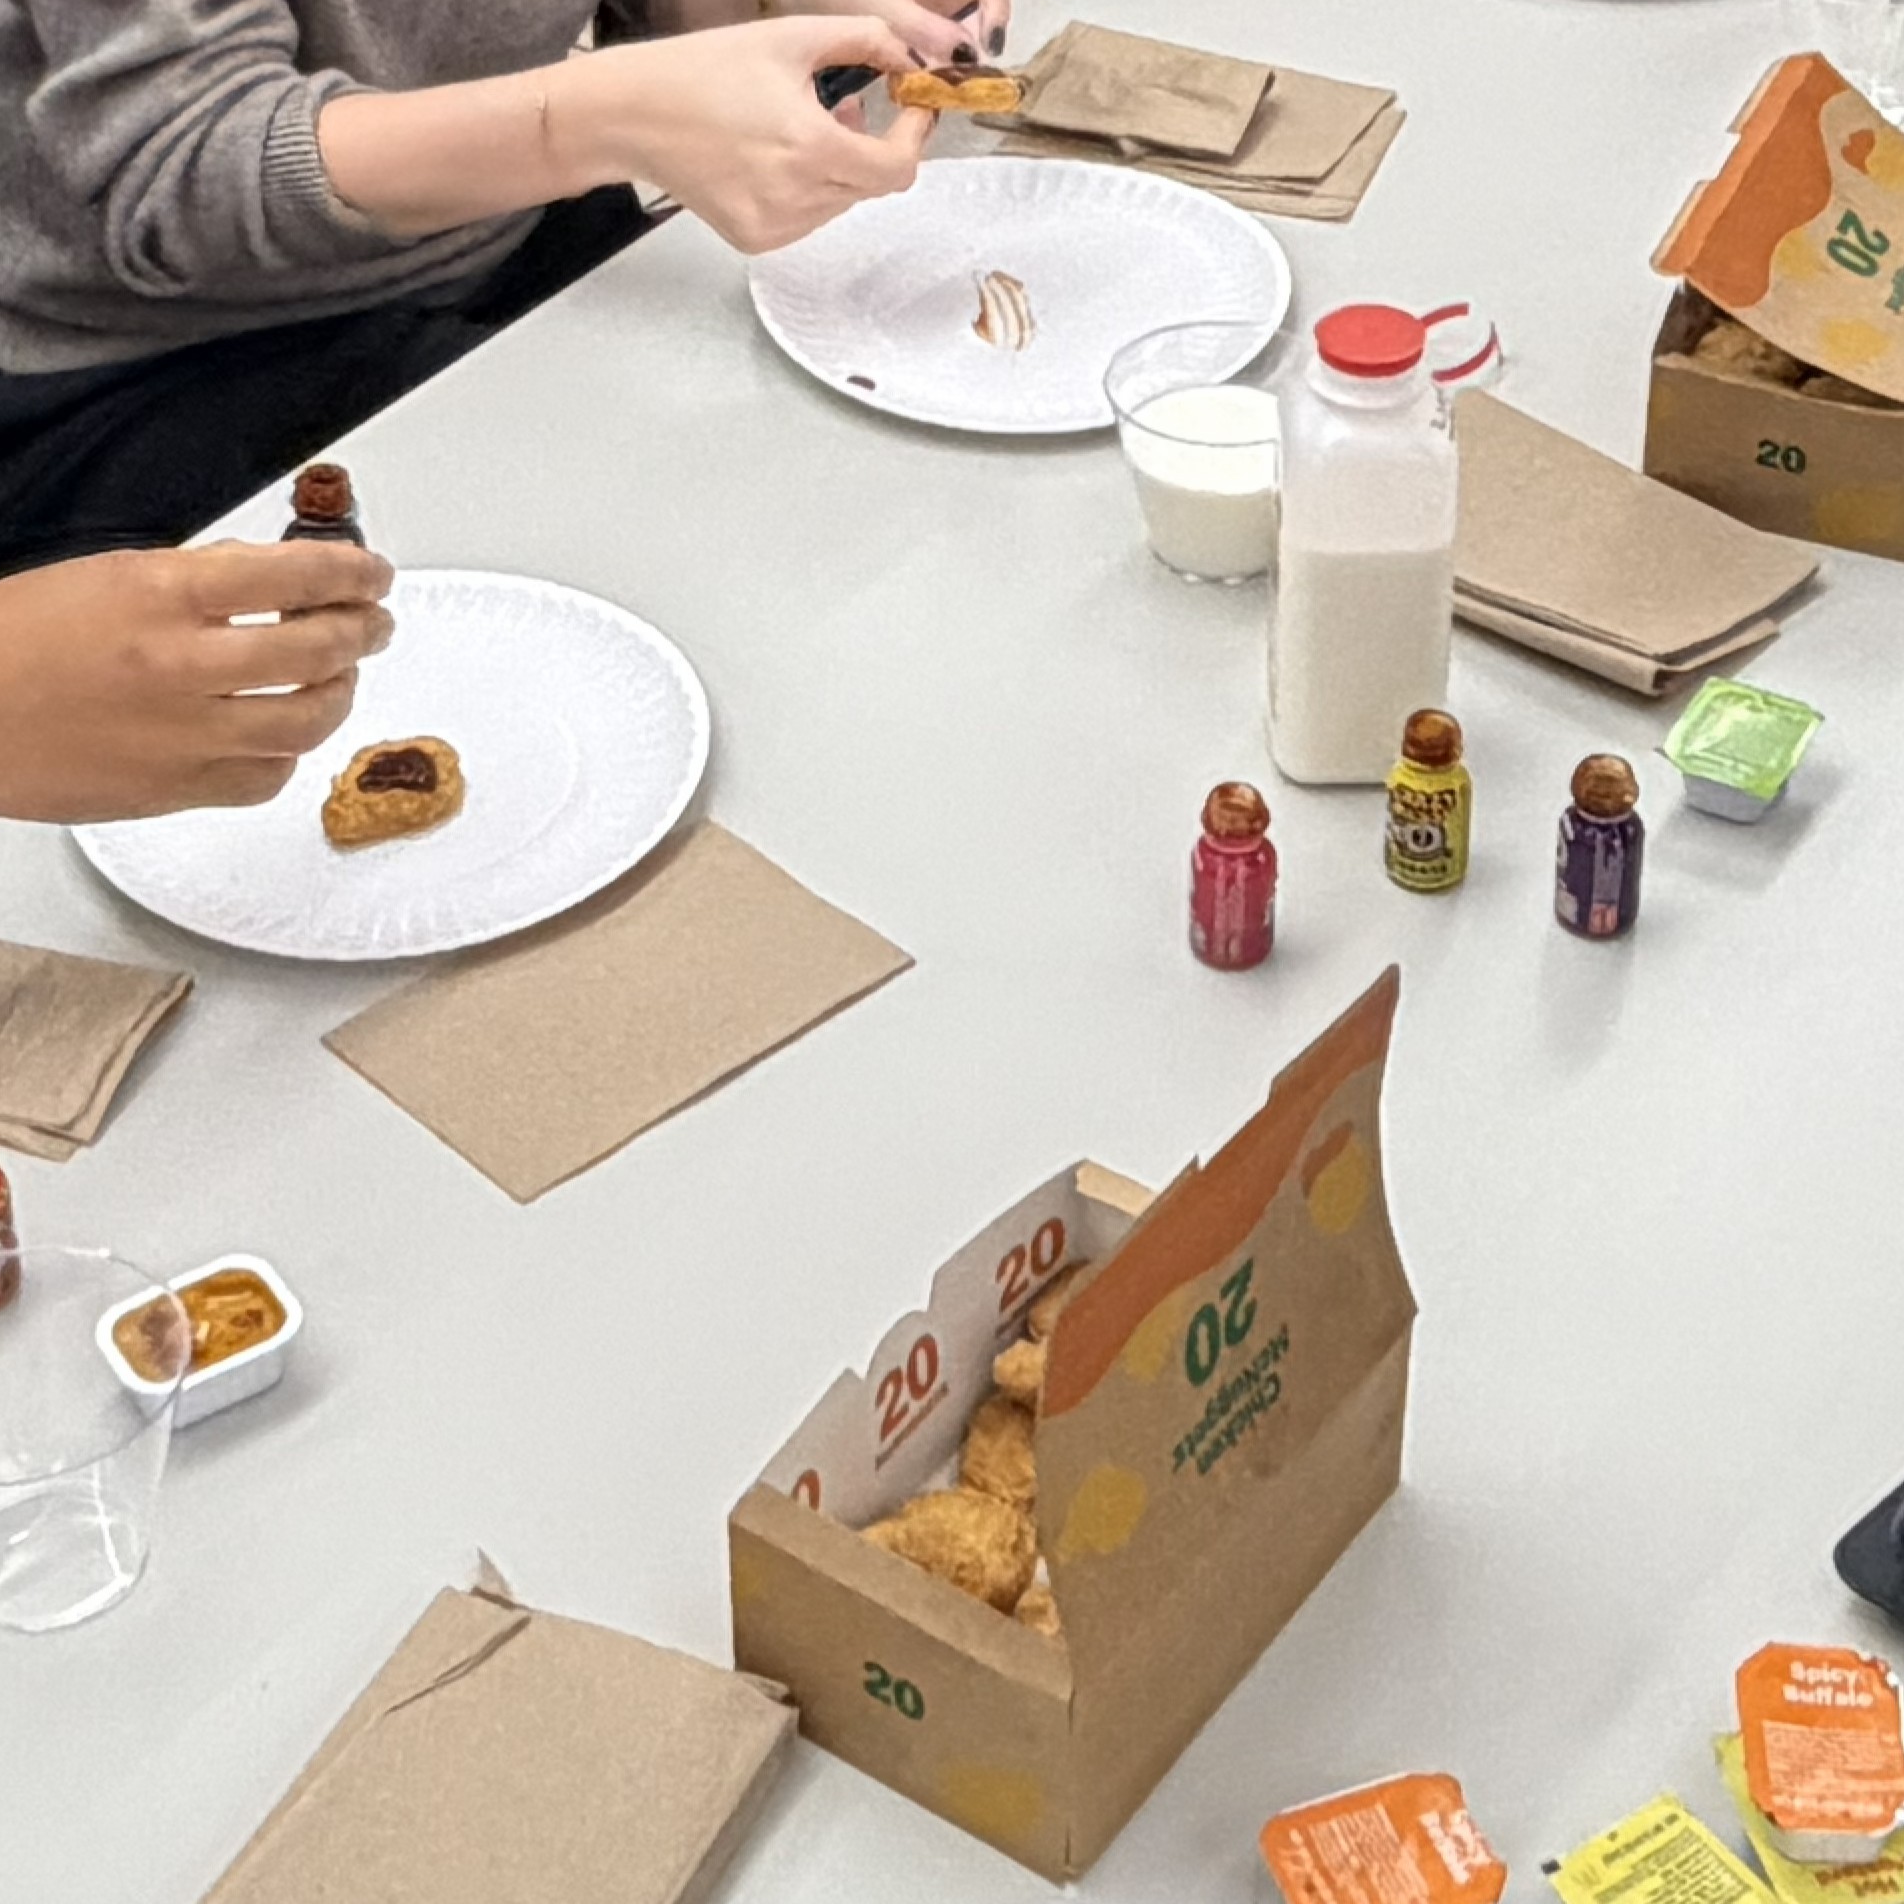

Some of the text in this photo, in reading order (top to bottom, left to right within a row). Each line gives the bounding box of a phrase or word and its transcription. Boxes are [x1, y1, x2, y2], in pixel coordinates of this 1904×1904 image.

[1827, 209, 1889, 278] 20
[1756, 439, 1806, 474] 20
[996, 1217, 1066, 1312] 20
[1185, 1257, 1257, 1387] 20
[876, 1333, 939, 1442] 20
[1197, 1372, 1281, 1475] Chicken
[862, 1661, 925, 1721] 20
[1783, 1684, 1874, 1708] Buffalo
[1790, 1661, 1858, 1694] Spicy
